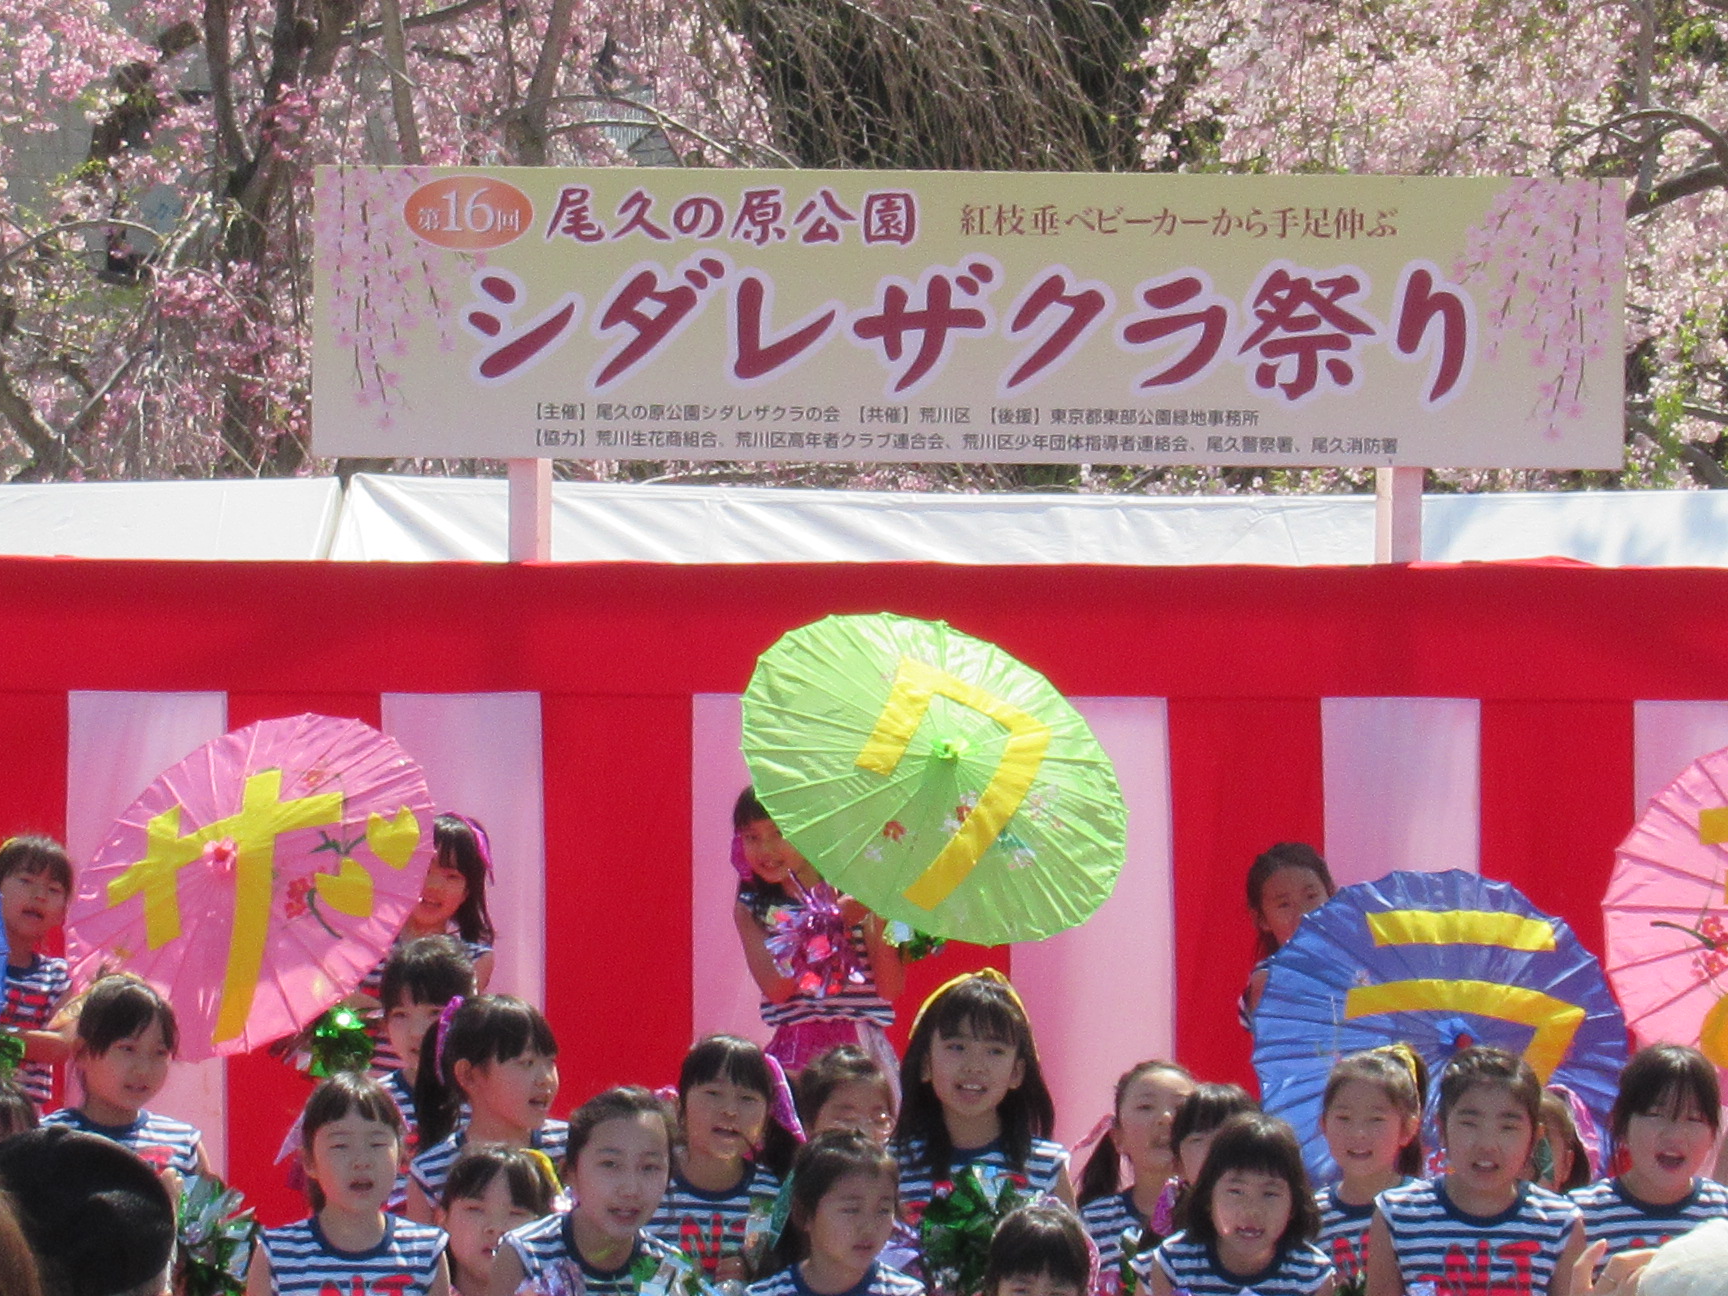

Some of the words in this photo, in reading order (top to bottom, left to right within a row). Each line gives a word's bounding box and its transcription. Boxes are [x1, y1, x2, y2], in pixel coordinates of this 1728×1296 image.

[418, 186, 520, 233] 第16回
[547, 188, 916, 245] 尾久の原公園
[468, 258, 1467, 401] シダレザクラ祭り
[855, 656, 1052, 912] ク
[107, 768, 420, 1046] ザ
